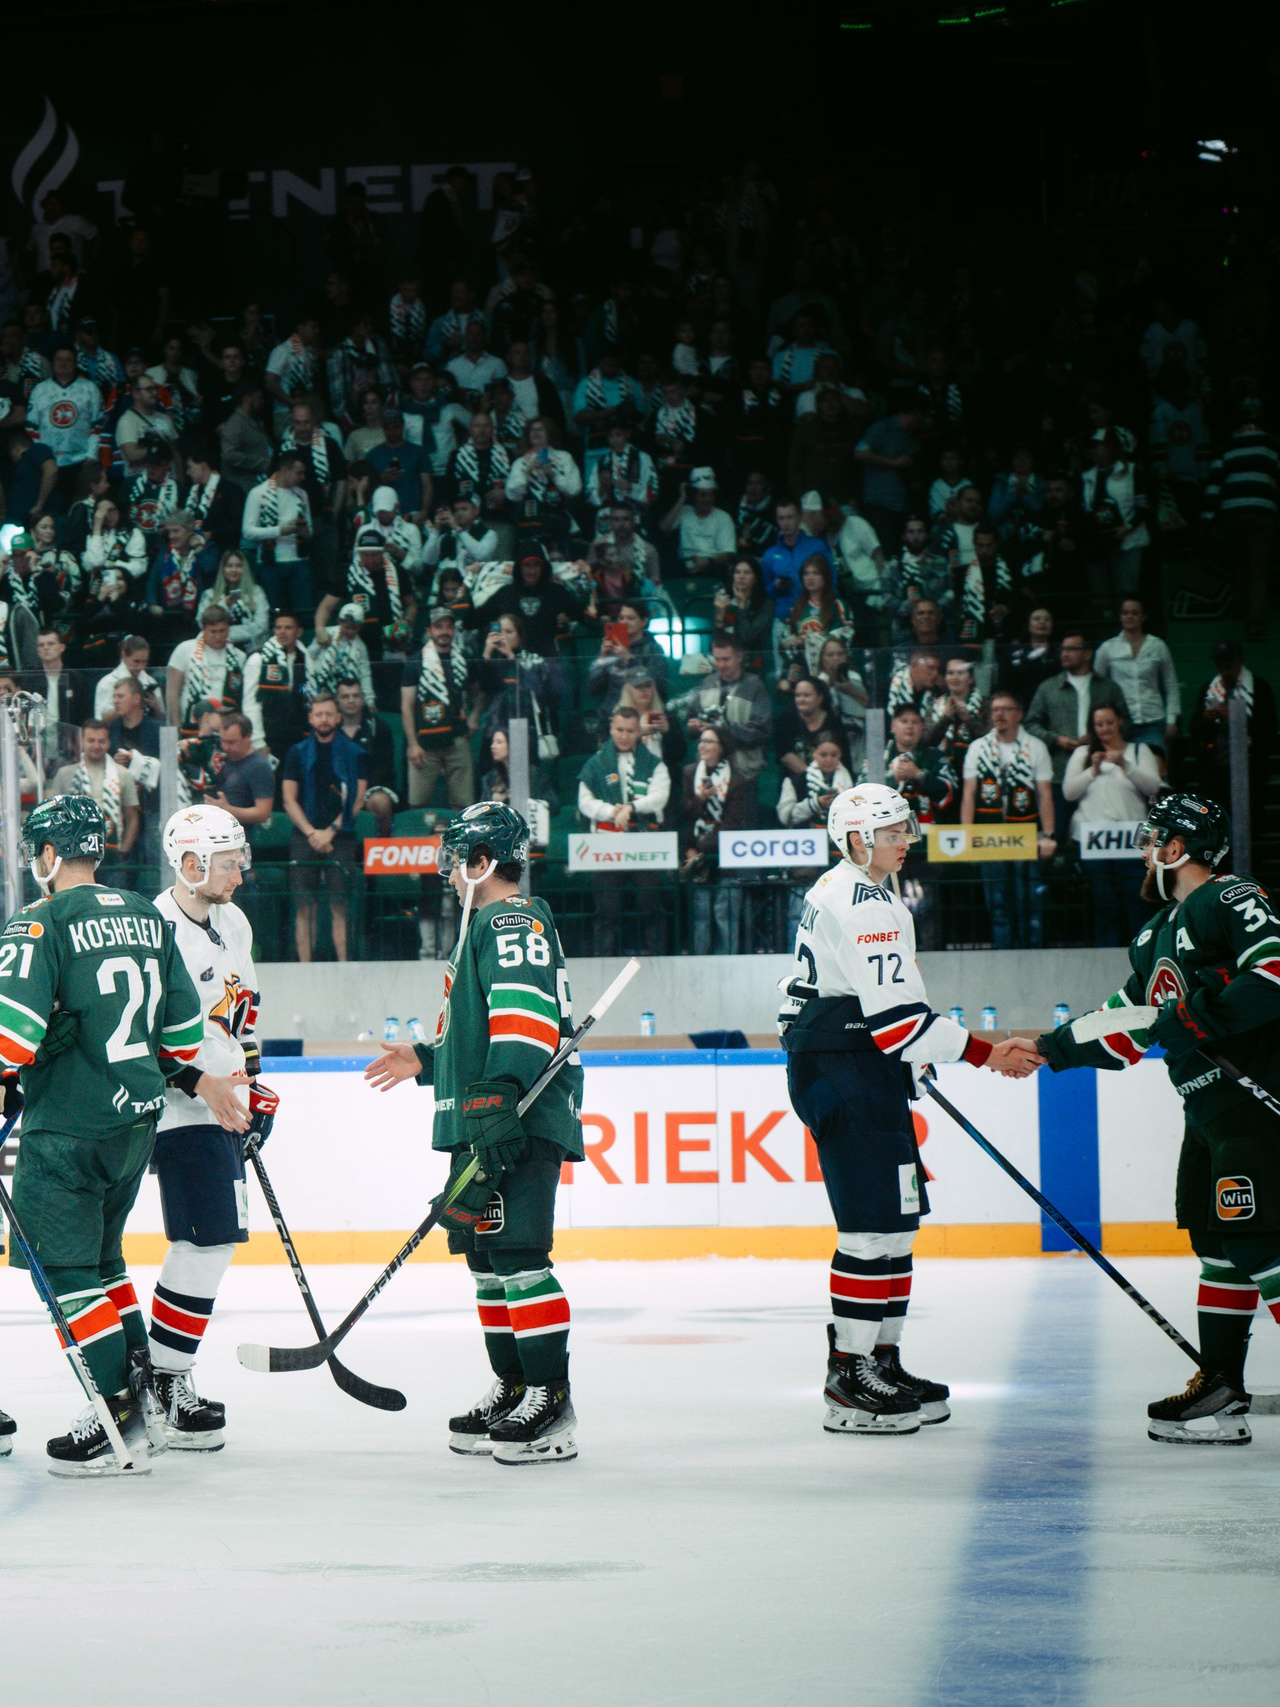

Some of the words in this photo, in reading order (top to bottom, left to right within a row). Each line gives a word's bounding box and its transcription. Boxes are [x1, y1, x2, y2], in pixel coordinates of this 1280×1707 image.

[96, 162, 517, 227] TTNEFT
[87, 836, 99, 852] 21
[971, 835, 1025, 849] БАНК
[366, 845, 440, 866] FONB
[593, 851, 670, 863] TATNEFT
[495, 915, 532, 928] Winline
[68, 916, 163, 953] KOSHELEV
[857, 930, 900, 945] FONBET
[1176, 927, 1196, 957] A
[496, 932, 551, 968] 58
[867, 952, 905, 986] 72
[96, 956, 163, 1064] 21
[844, 1022, 867, 1030] BAU
[462, 1096, 503, 1113] UER
[558, 1111, 936, 1185] RIEK
[1222, 1192, 1252, 1205] Win
[365, 1231, 423, 1306] BAUER
